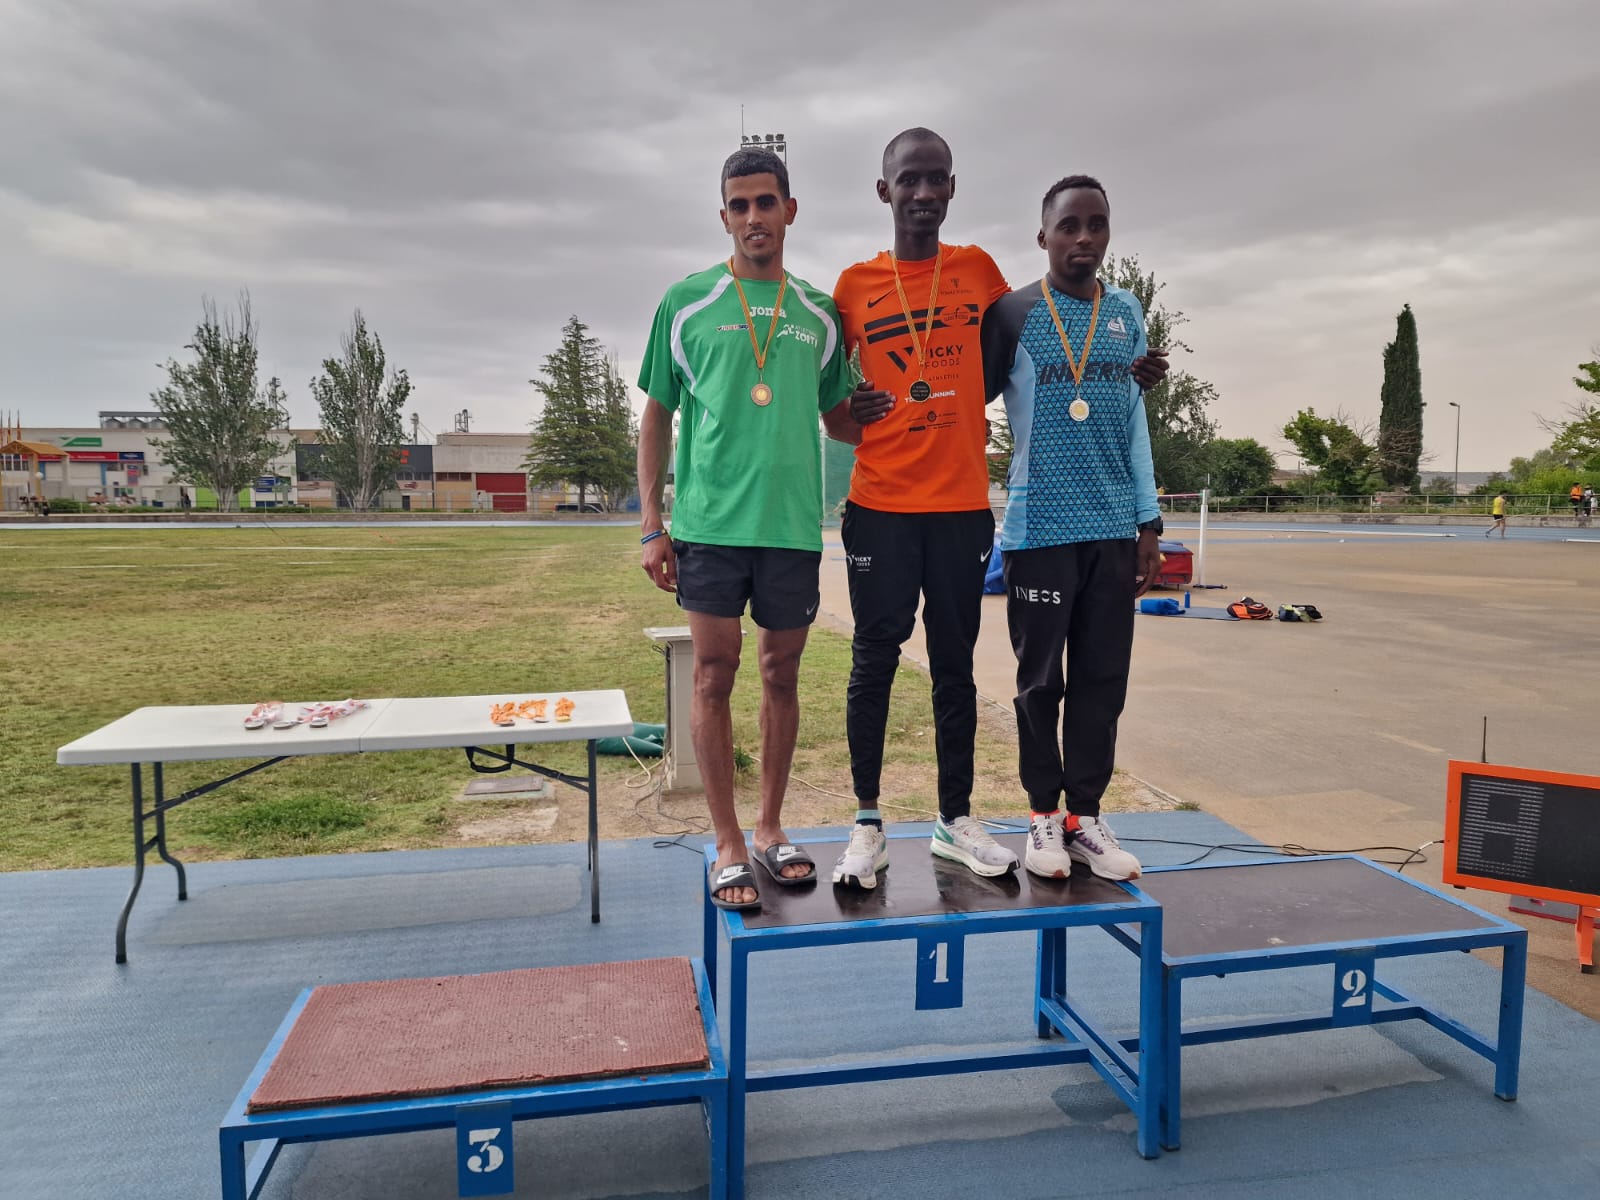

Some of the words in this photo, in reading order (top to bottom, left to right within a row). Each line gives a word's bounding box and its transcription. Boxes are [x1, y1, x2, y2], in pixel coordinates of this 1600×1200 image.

[1015, 586, 1061, 604] INEOS
[929, 942, 949, 983] 1
[1341, 969, 1367, 1008] 2
[467, 1127, 504, 1173] 3
